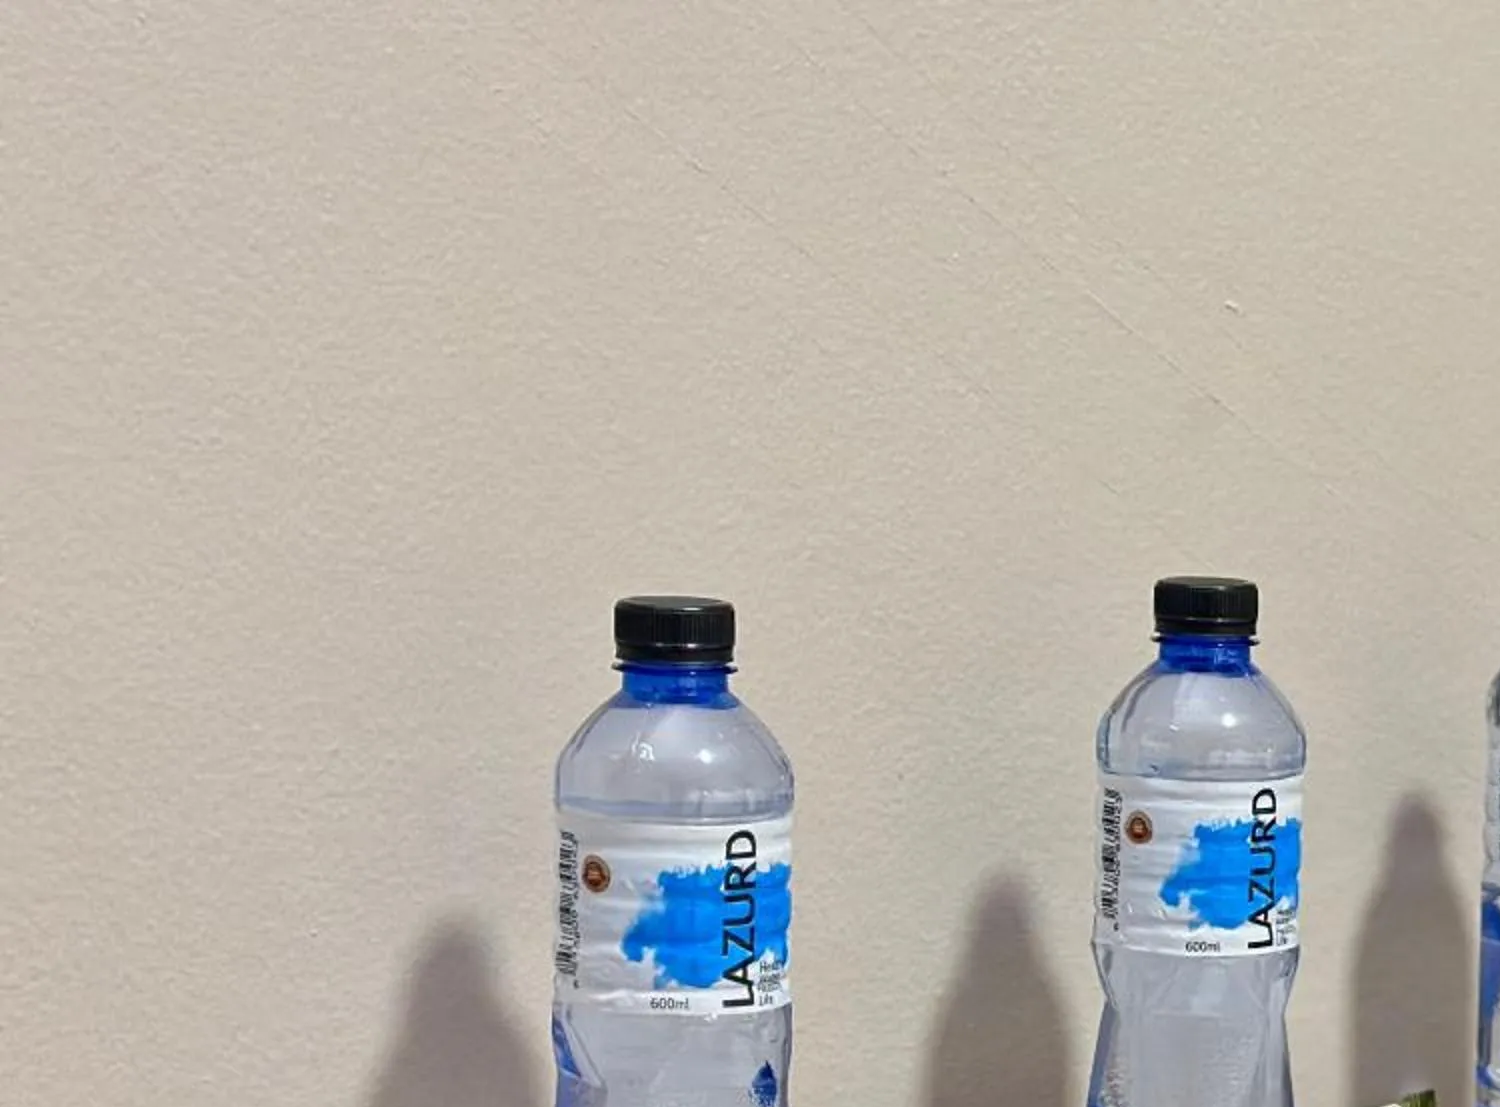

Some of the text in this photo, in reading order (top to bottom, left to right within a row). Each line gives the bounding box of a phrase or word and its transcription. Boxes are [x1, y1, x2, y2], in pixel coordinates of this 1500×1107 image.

[722, 830, 757, 1008] LAZURD
[1248, 788, 1277, 949] LAZURD
[650, 997, 689, 1009] 600ml
